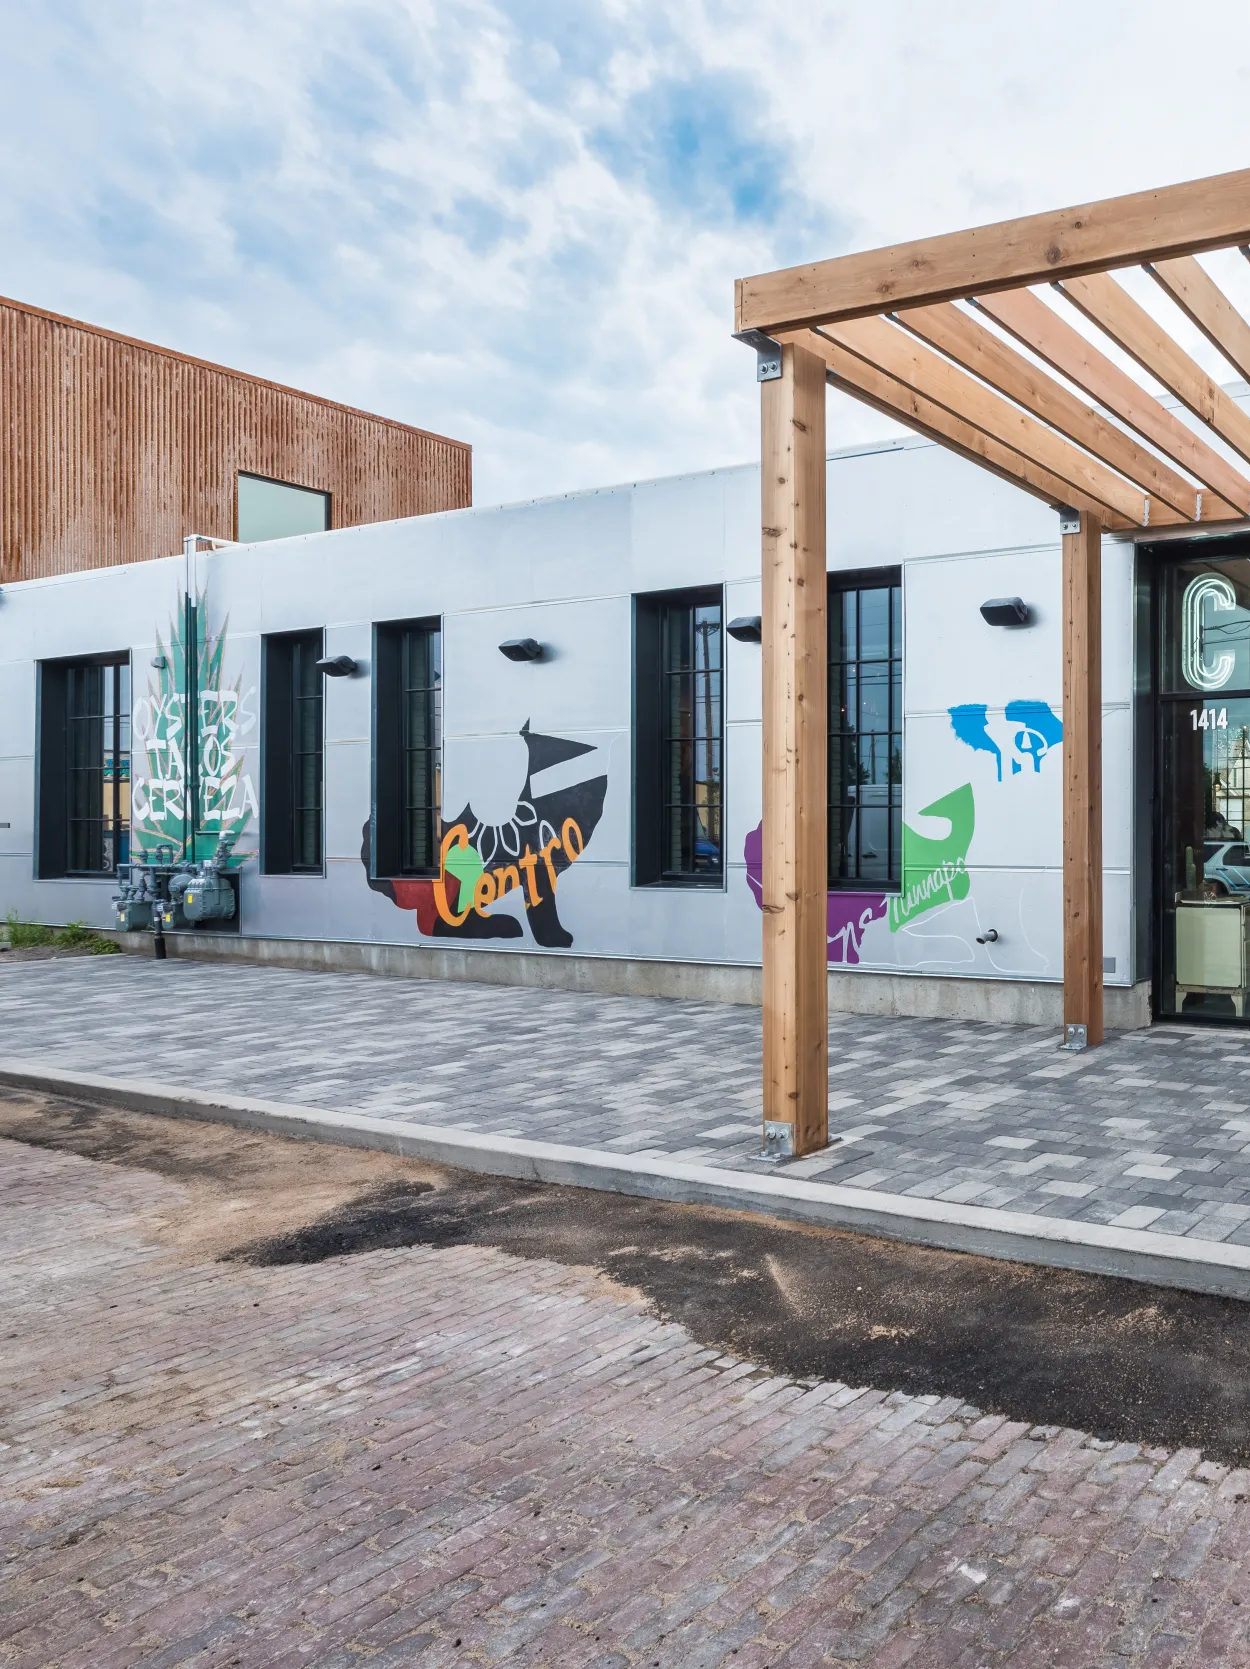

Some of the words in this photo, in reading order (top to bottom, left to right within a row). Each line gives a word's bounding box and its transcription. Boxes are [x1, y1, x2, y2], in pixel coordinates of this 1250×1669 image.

[1190, 708, 1228, 730] 1414
[145, 732, 237, 780] TAOS
[432, 817, 584, 927] Centro
